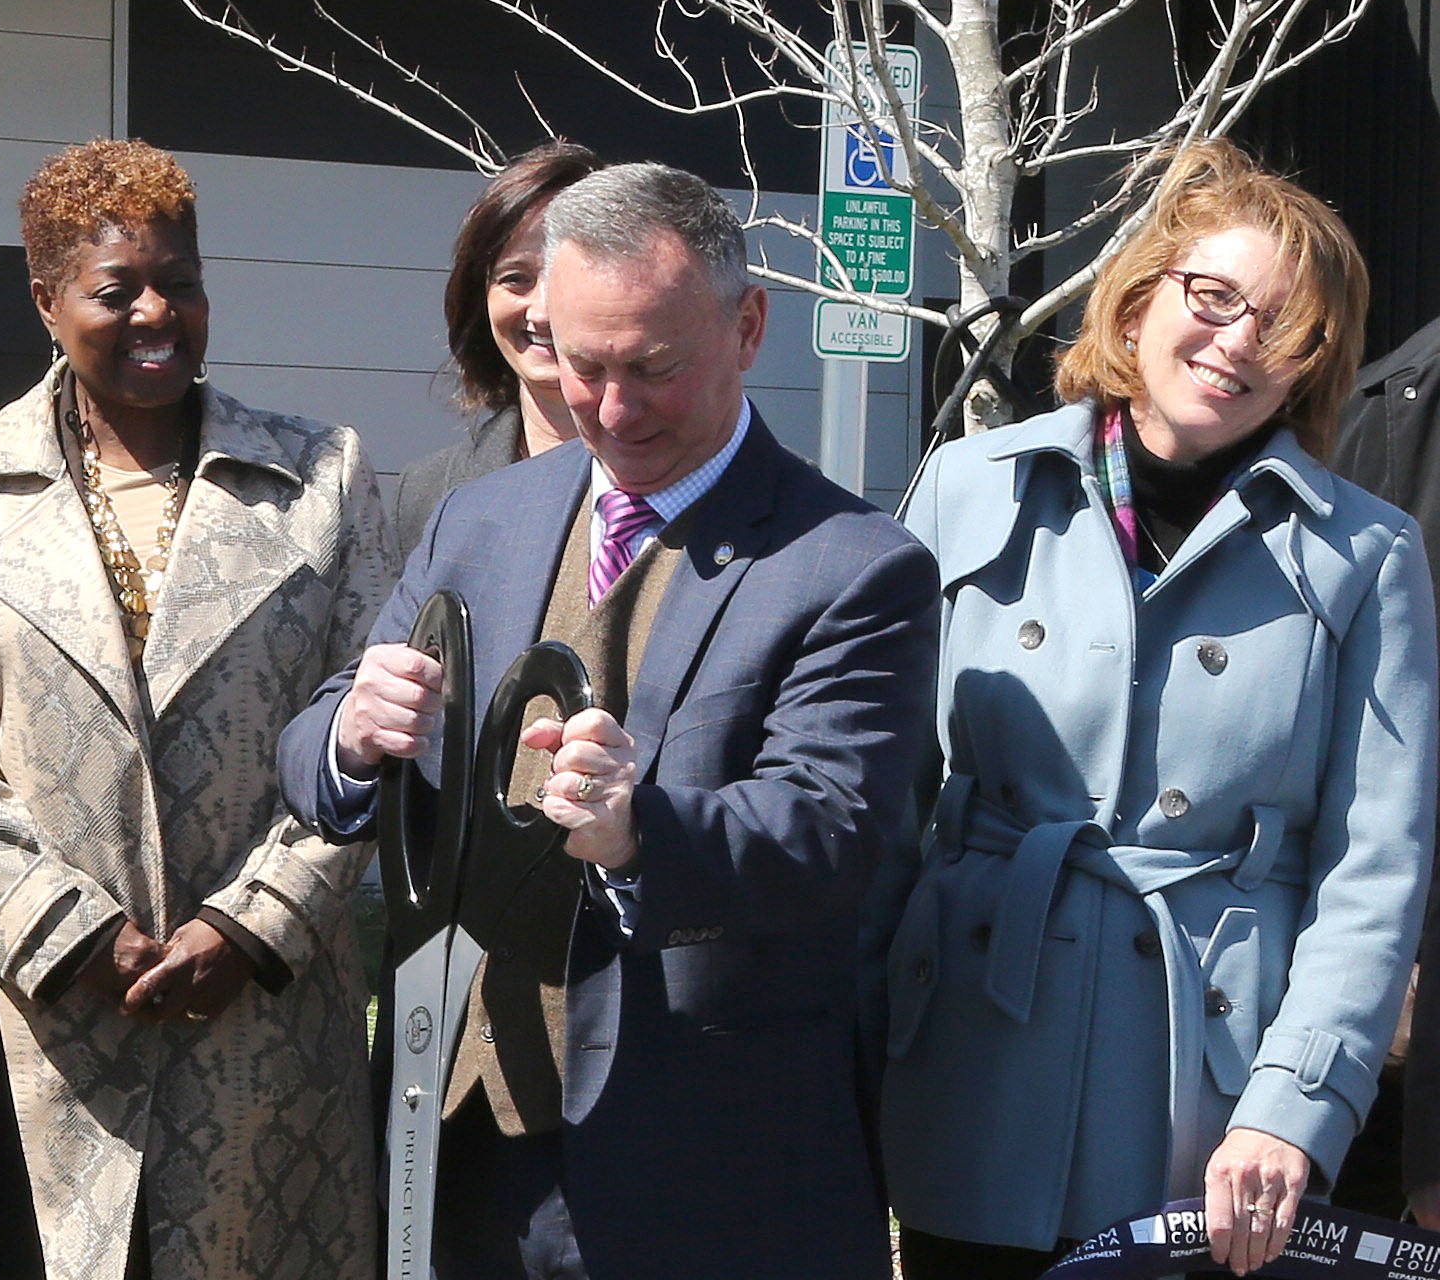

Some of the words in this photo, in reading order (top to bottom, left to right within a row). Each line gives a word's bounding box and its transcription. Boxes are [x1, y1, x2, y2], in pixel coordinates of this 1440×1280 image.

[846, 200, 890, 215] UNLAWFUL
[833, 216, 868, 230] PARKING
[870, 218, 880, 231] IN
[882, 219, 901, 233] THIS
[828, 232, 854, 246] SPACE
[856, 234, 866, 247] IS
[868, 235, 905, 249] SUBJECT
[846, 250, 856, 263] TO
[859, 251, 865, 264] A
[867, 251, 886, 265] FINE
[847, 313, 879, 330] VAN
[830, 332, 894, 347] ACCESSIBLE
[403, 1130, 415, 1215] PRINCE
[1167, 1211, 1206, 1231] PRI
